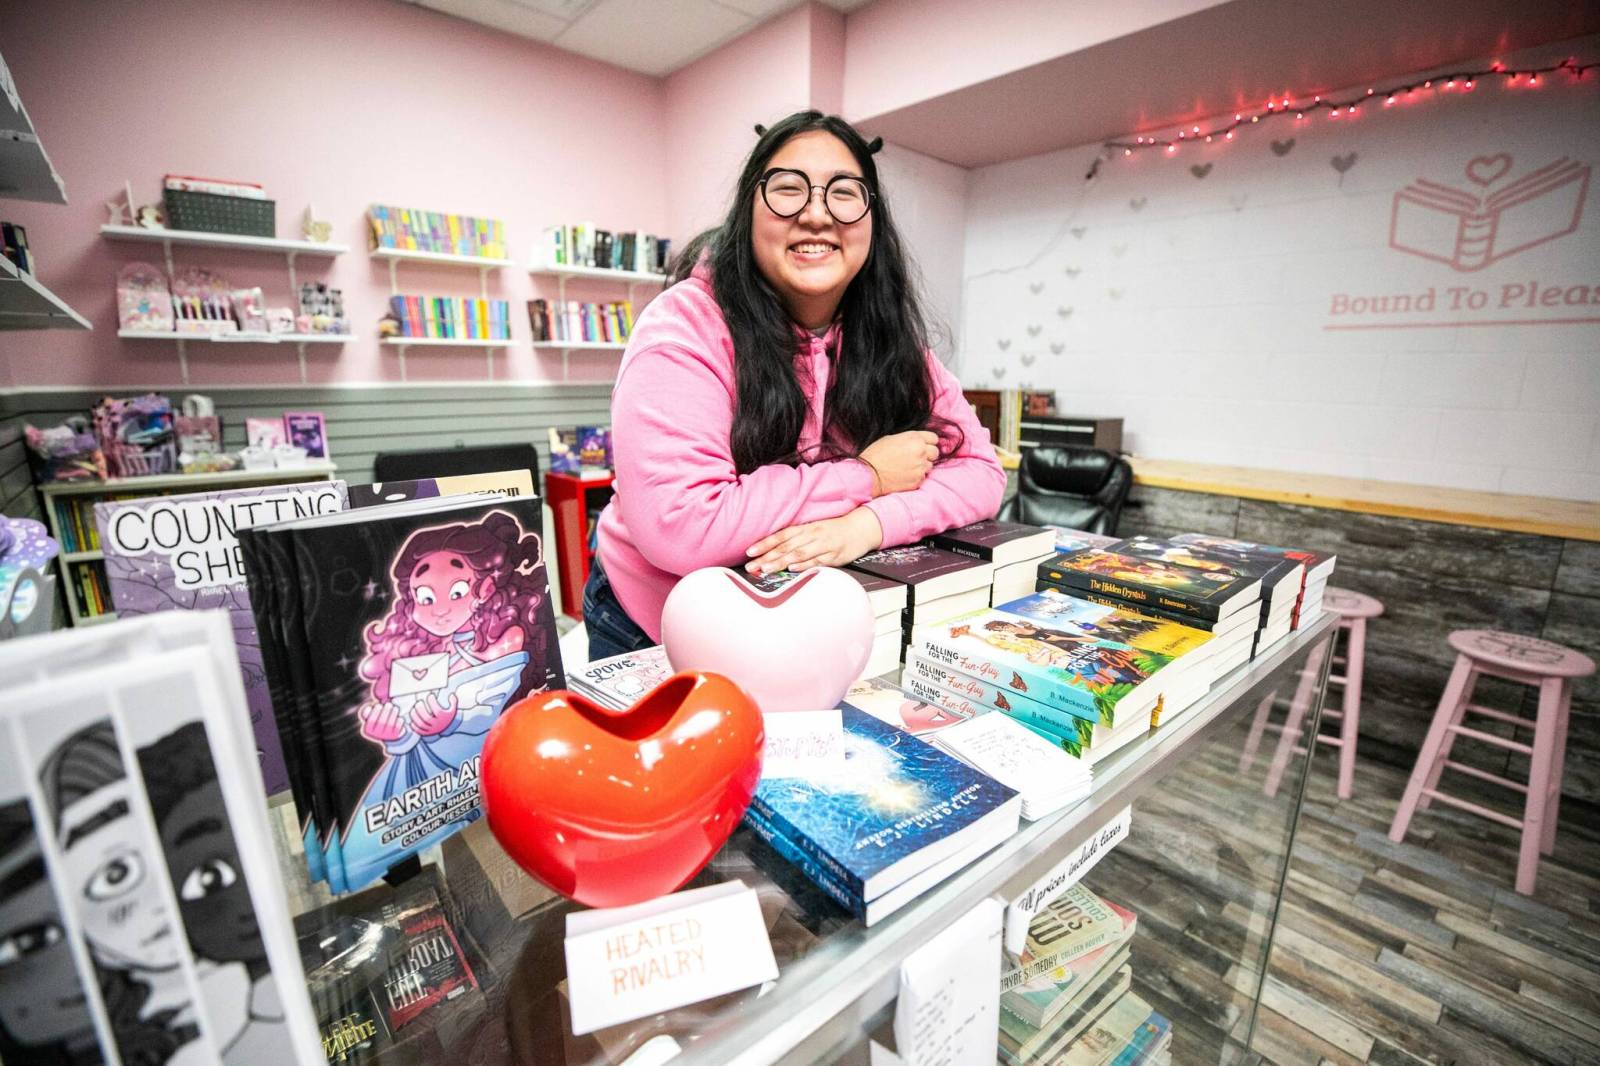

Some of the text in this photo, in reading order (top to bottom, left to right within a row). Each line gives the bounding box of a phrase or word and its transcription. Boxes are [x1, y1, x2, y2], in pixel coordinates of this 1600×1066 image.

[1329, 287, 1436, 316] Bound
[1446, 286, 1488, 310] To
[115, 493, 337, 551] COUNTING
[1090, 579, 1102, 590] The
[1101, 581, 1122, 594] Hidden
[926, 642, 999, 679] FALLING Fun-Guy
[928, 650, 953, 665] FOR THE
[915, 661, 985, 698] FALLING Fun-Guy
[918, 669, 942, 683] FOR THE
[911, 680, 977, 717] FALLING Fun-Guy
[913, 688, 935, 702] FOR THE
[1059, 695, 1095, 713] Mackenzie
[1040, 714, 1073, 732] Mackenzie
[365, 769, 453, 834] EARTH
[950, 783, 981, 804] AUTHOR
[381, 820, 417, 844] STORY
[425, 805, 446, 822] ART:
[445, 787, 477, 811] RHAEL
[444, 803, 472, 824] JESSE
[1033, 872, 1066, 913] prices
[1068, 837, 1098, 876] include
[1100, 824, 1122, 847] taxes
[605, 918, 703, 961] HEATED
[1023, 953, 1059, 980] SOMEDAY
[1060, 940, 1085, 960] COLLEEN
